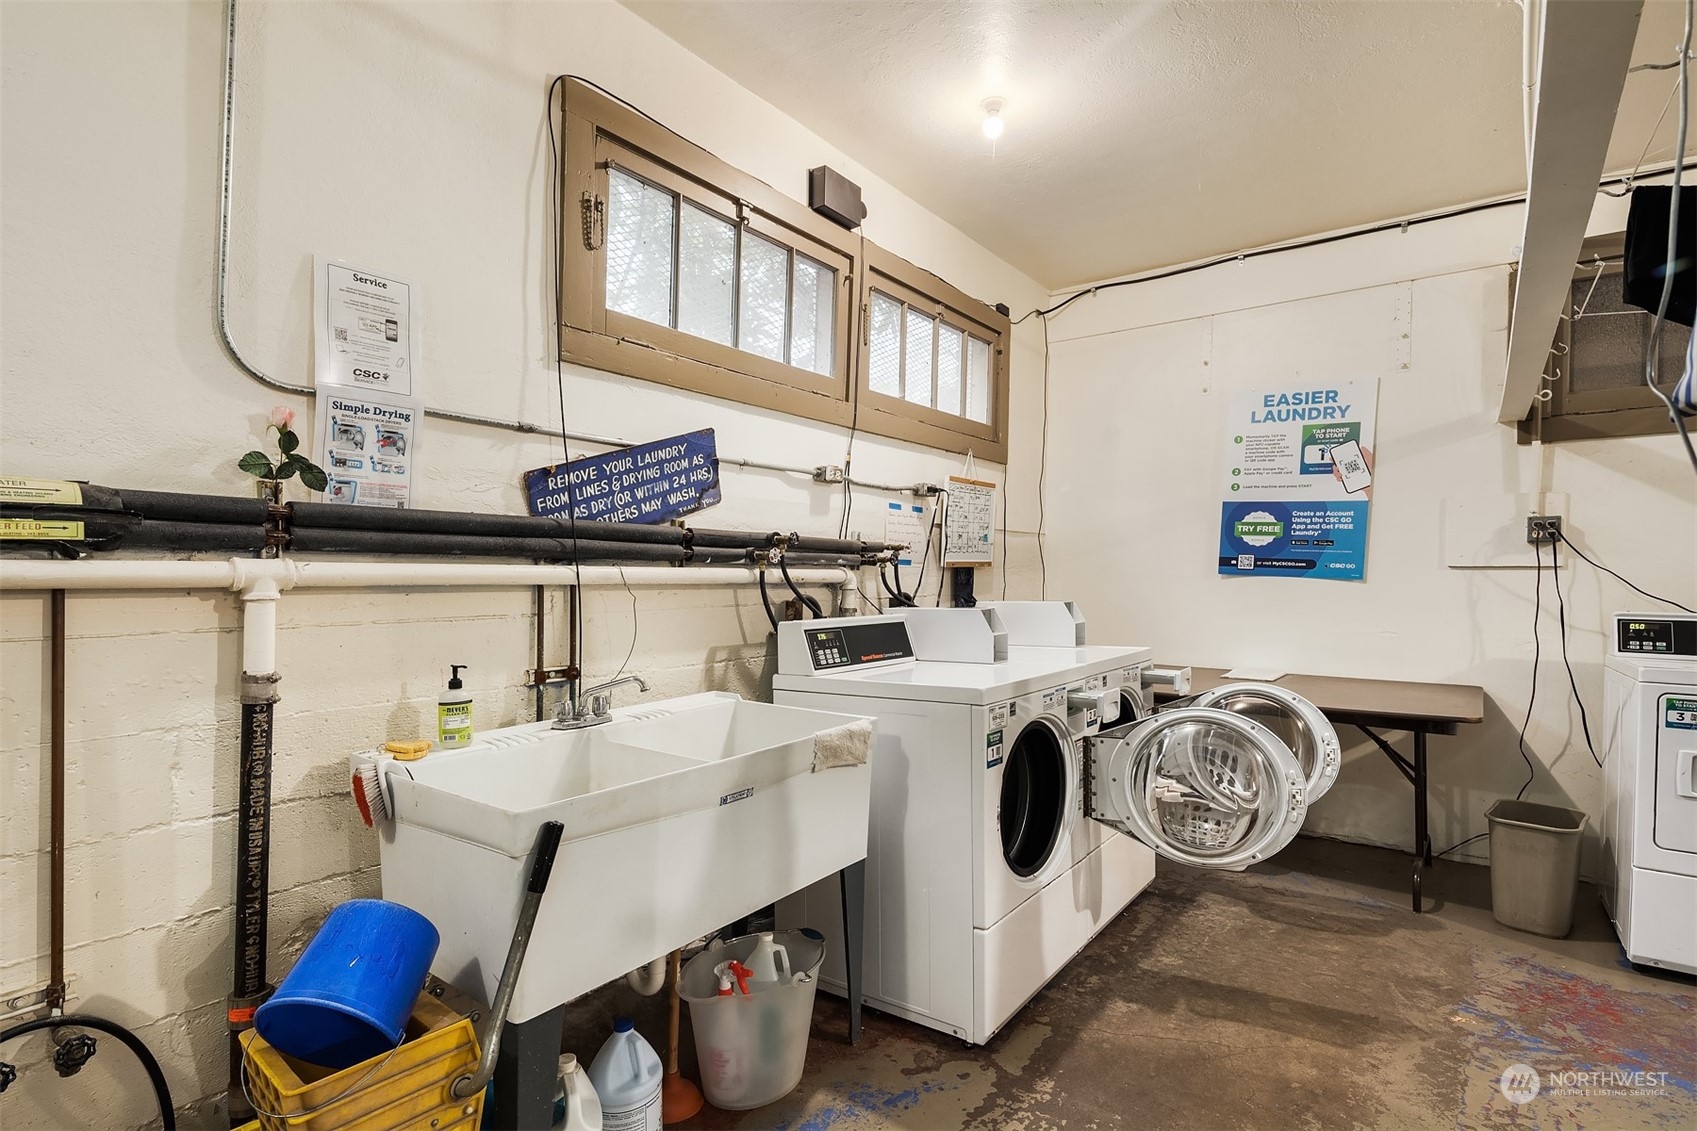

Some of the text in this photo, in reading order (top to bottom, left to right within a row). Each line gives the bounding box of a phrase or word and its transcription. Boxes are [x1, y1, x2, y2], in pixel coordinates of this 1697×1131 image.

[352, 273, 388, 290] Service
[353, 368, 380, 380] CSC
[1264, 390, 1339, 408] EASIER
[332, 400, 370, 414] Simple
[373, 406, 411, 422] Drying
[1250, 404, 1351, 424] LAUNDRY
[548, 442, 688, 490] REMOVE YOUR LAUNDRY
[537, 454, 704, 512] FROM LINES & DRYING ROOM AS
[574, 504, 588, 519] AS
[590, 496, 612, 514] DRY
[634, 480, 670, 499] WITHIN
[673, 475, 686, 487] 24
[690, 464, 714, 483] HRS.)
[641, 497, 662, 514] MAY
[666, 486, 700, 506] WASH.
[678, 502, 700, 513] THANK
[1676, 712, 1685, 721] 3
[249, 777, 266, 817] MADE
[248, 818, 264, 830] IN
[245, 894, 261, 934] TYLER
